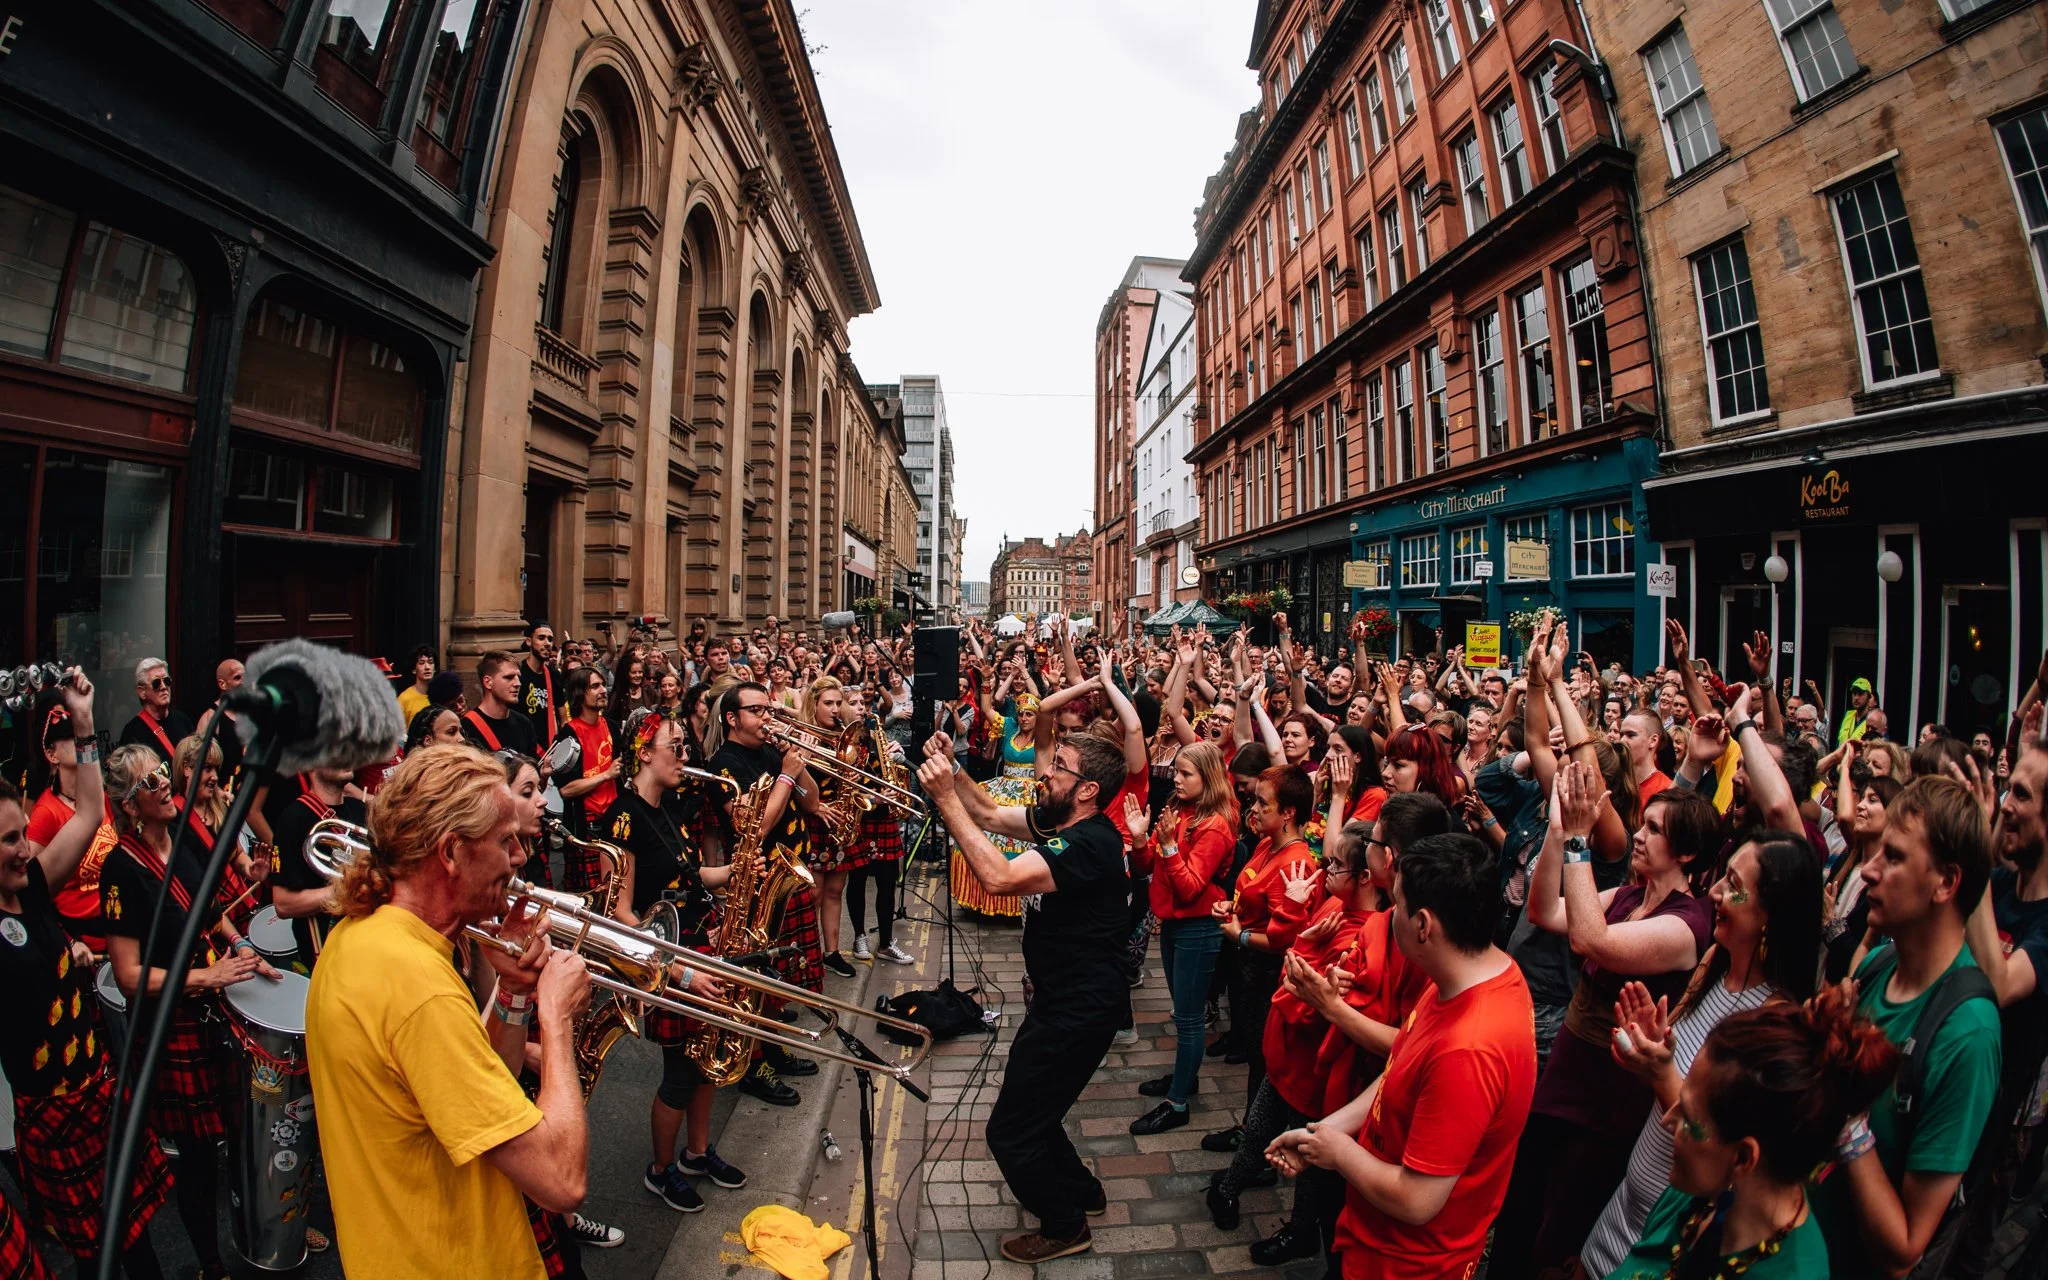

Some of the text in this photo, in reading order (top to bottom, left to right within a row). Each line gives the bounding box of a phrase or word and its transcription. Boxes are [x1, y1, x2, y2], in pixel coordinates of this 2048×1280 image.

[1805, 506, 1849, 518] RESTAURANT
[1511, 562, 1545, 571] MERCHANT
[1469, 633, 1497, 642] Vintage
